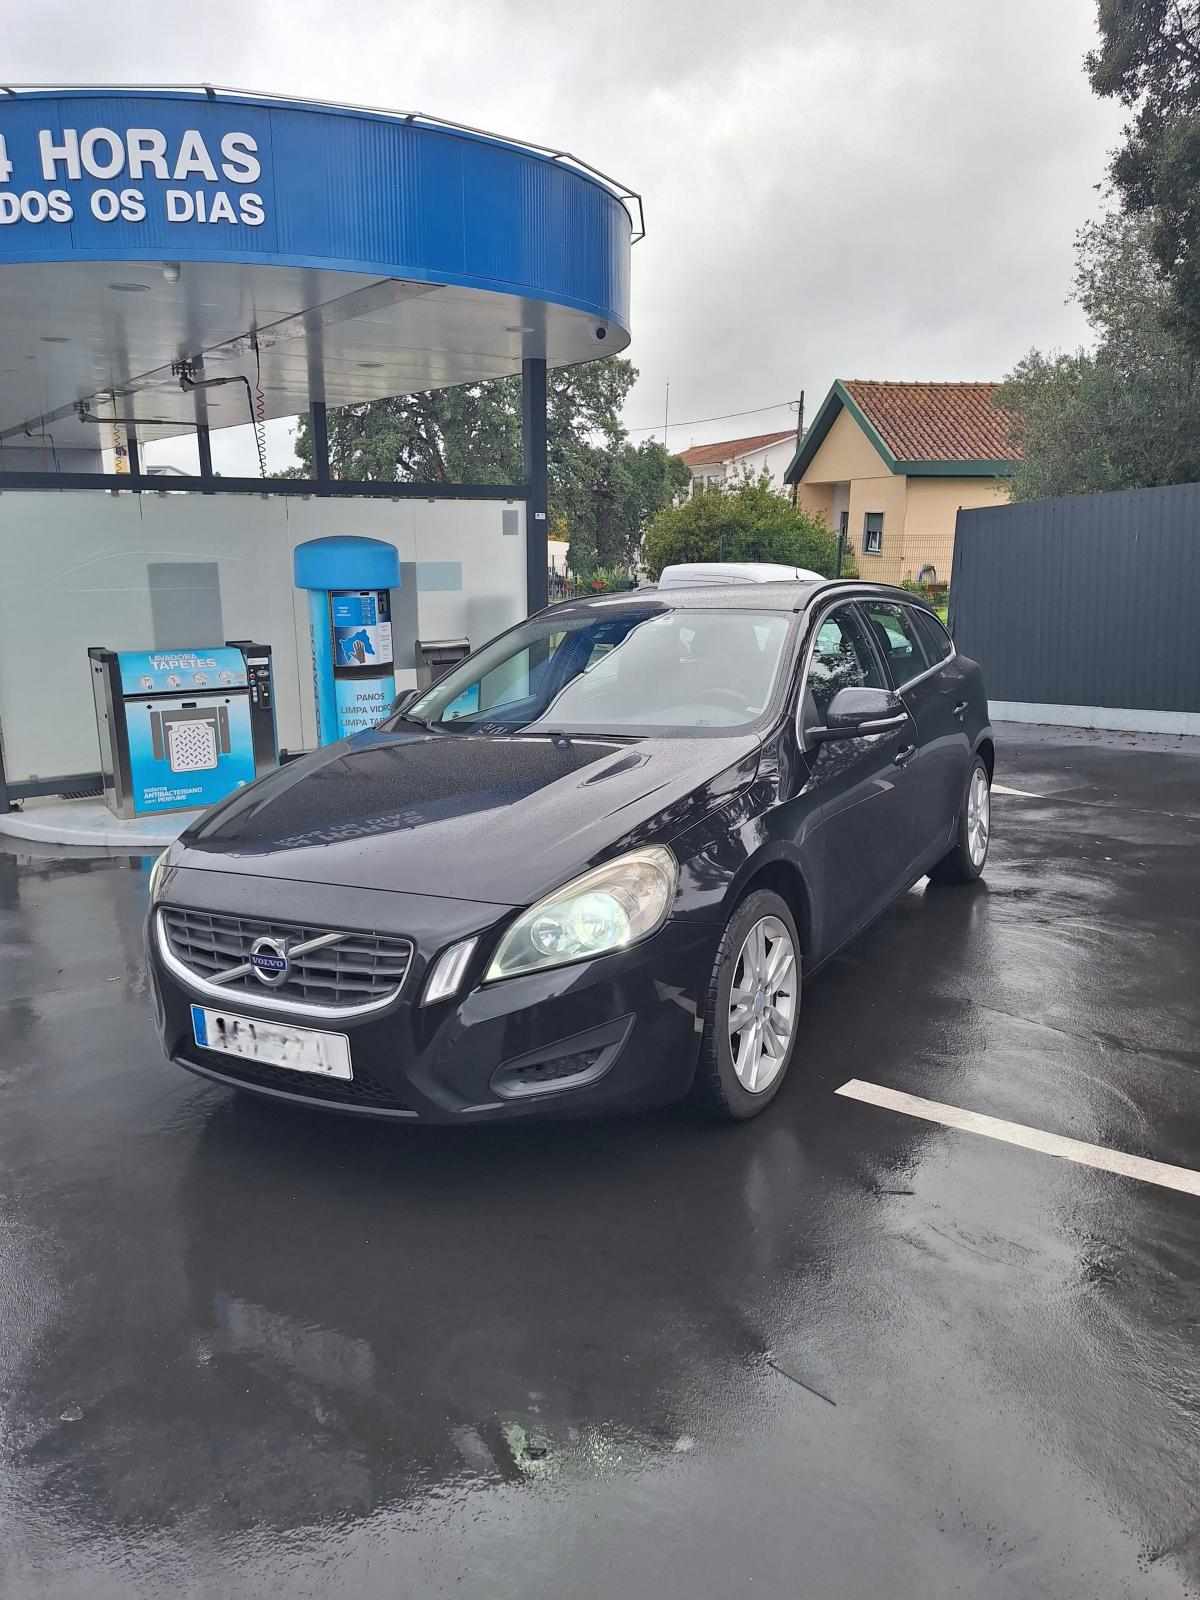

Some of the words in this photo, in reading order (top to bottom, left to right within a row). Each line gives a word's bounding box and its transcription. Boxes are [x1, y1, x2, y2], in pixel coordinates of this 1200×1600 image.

[38, 127, 261, 184] HORAS
[90, 188, 146, 222] OS
[166, 189, 265, 226] DIAS
[152, 658, 217, 671] TAPETES
[356, 693, 385, 702] PANOS
[341, 706, 368, 714] LIMPA
[252, 956, 284, 967] VOLVO
